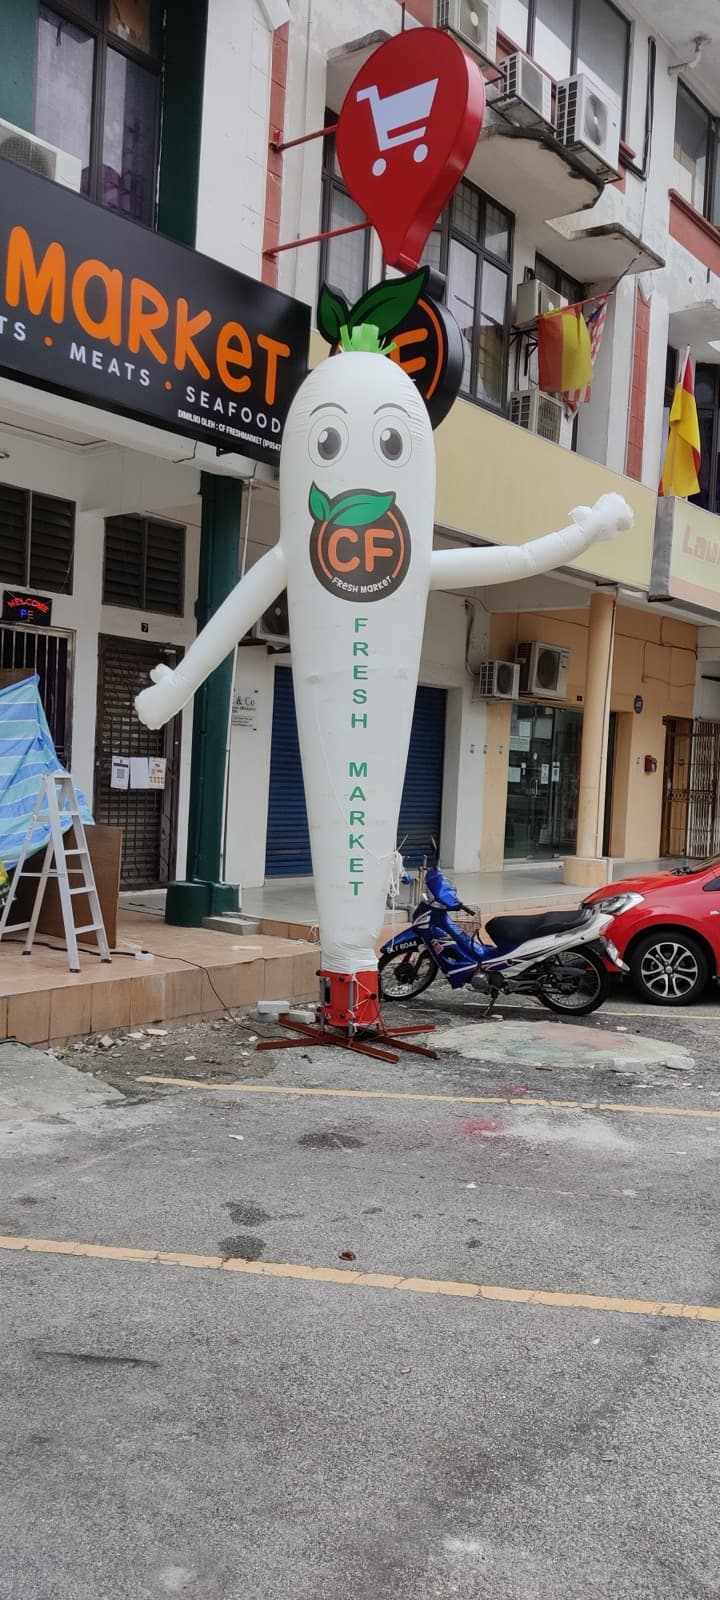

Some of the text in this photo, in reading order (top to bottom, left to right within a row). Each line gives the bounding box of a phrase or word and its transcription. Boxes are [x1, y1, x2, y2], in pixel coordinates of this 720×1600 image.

[70, 342, 150, 386] MEATS
[185, 385, 281, 433] SEAFOOD
[177, 409, 201, 424] DIMILIKI
[201, 417, 216, 429] OLEH
[226, 426, 262, 444] FRESHMARKET
[327, 527, 395, 573] CF
[7, 597, 49, 613] WELCOME
[348, 617, 369, 896] FRESH MARKET
